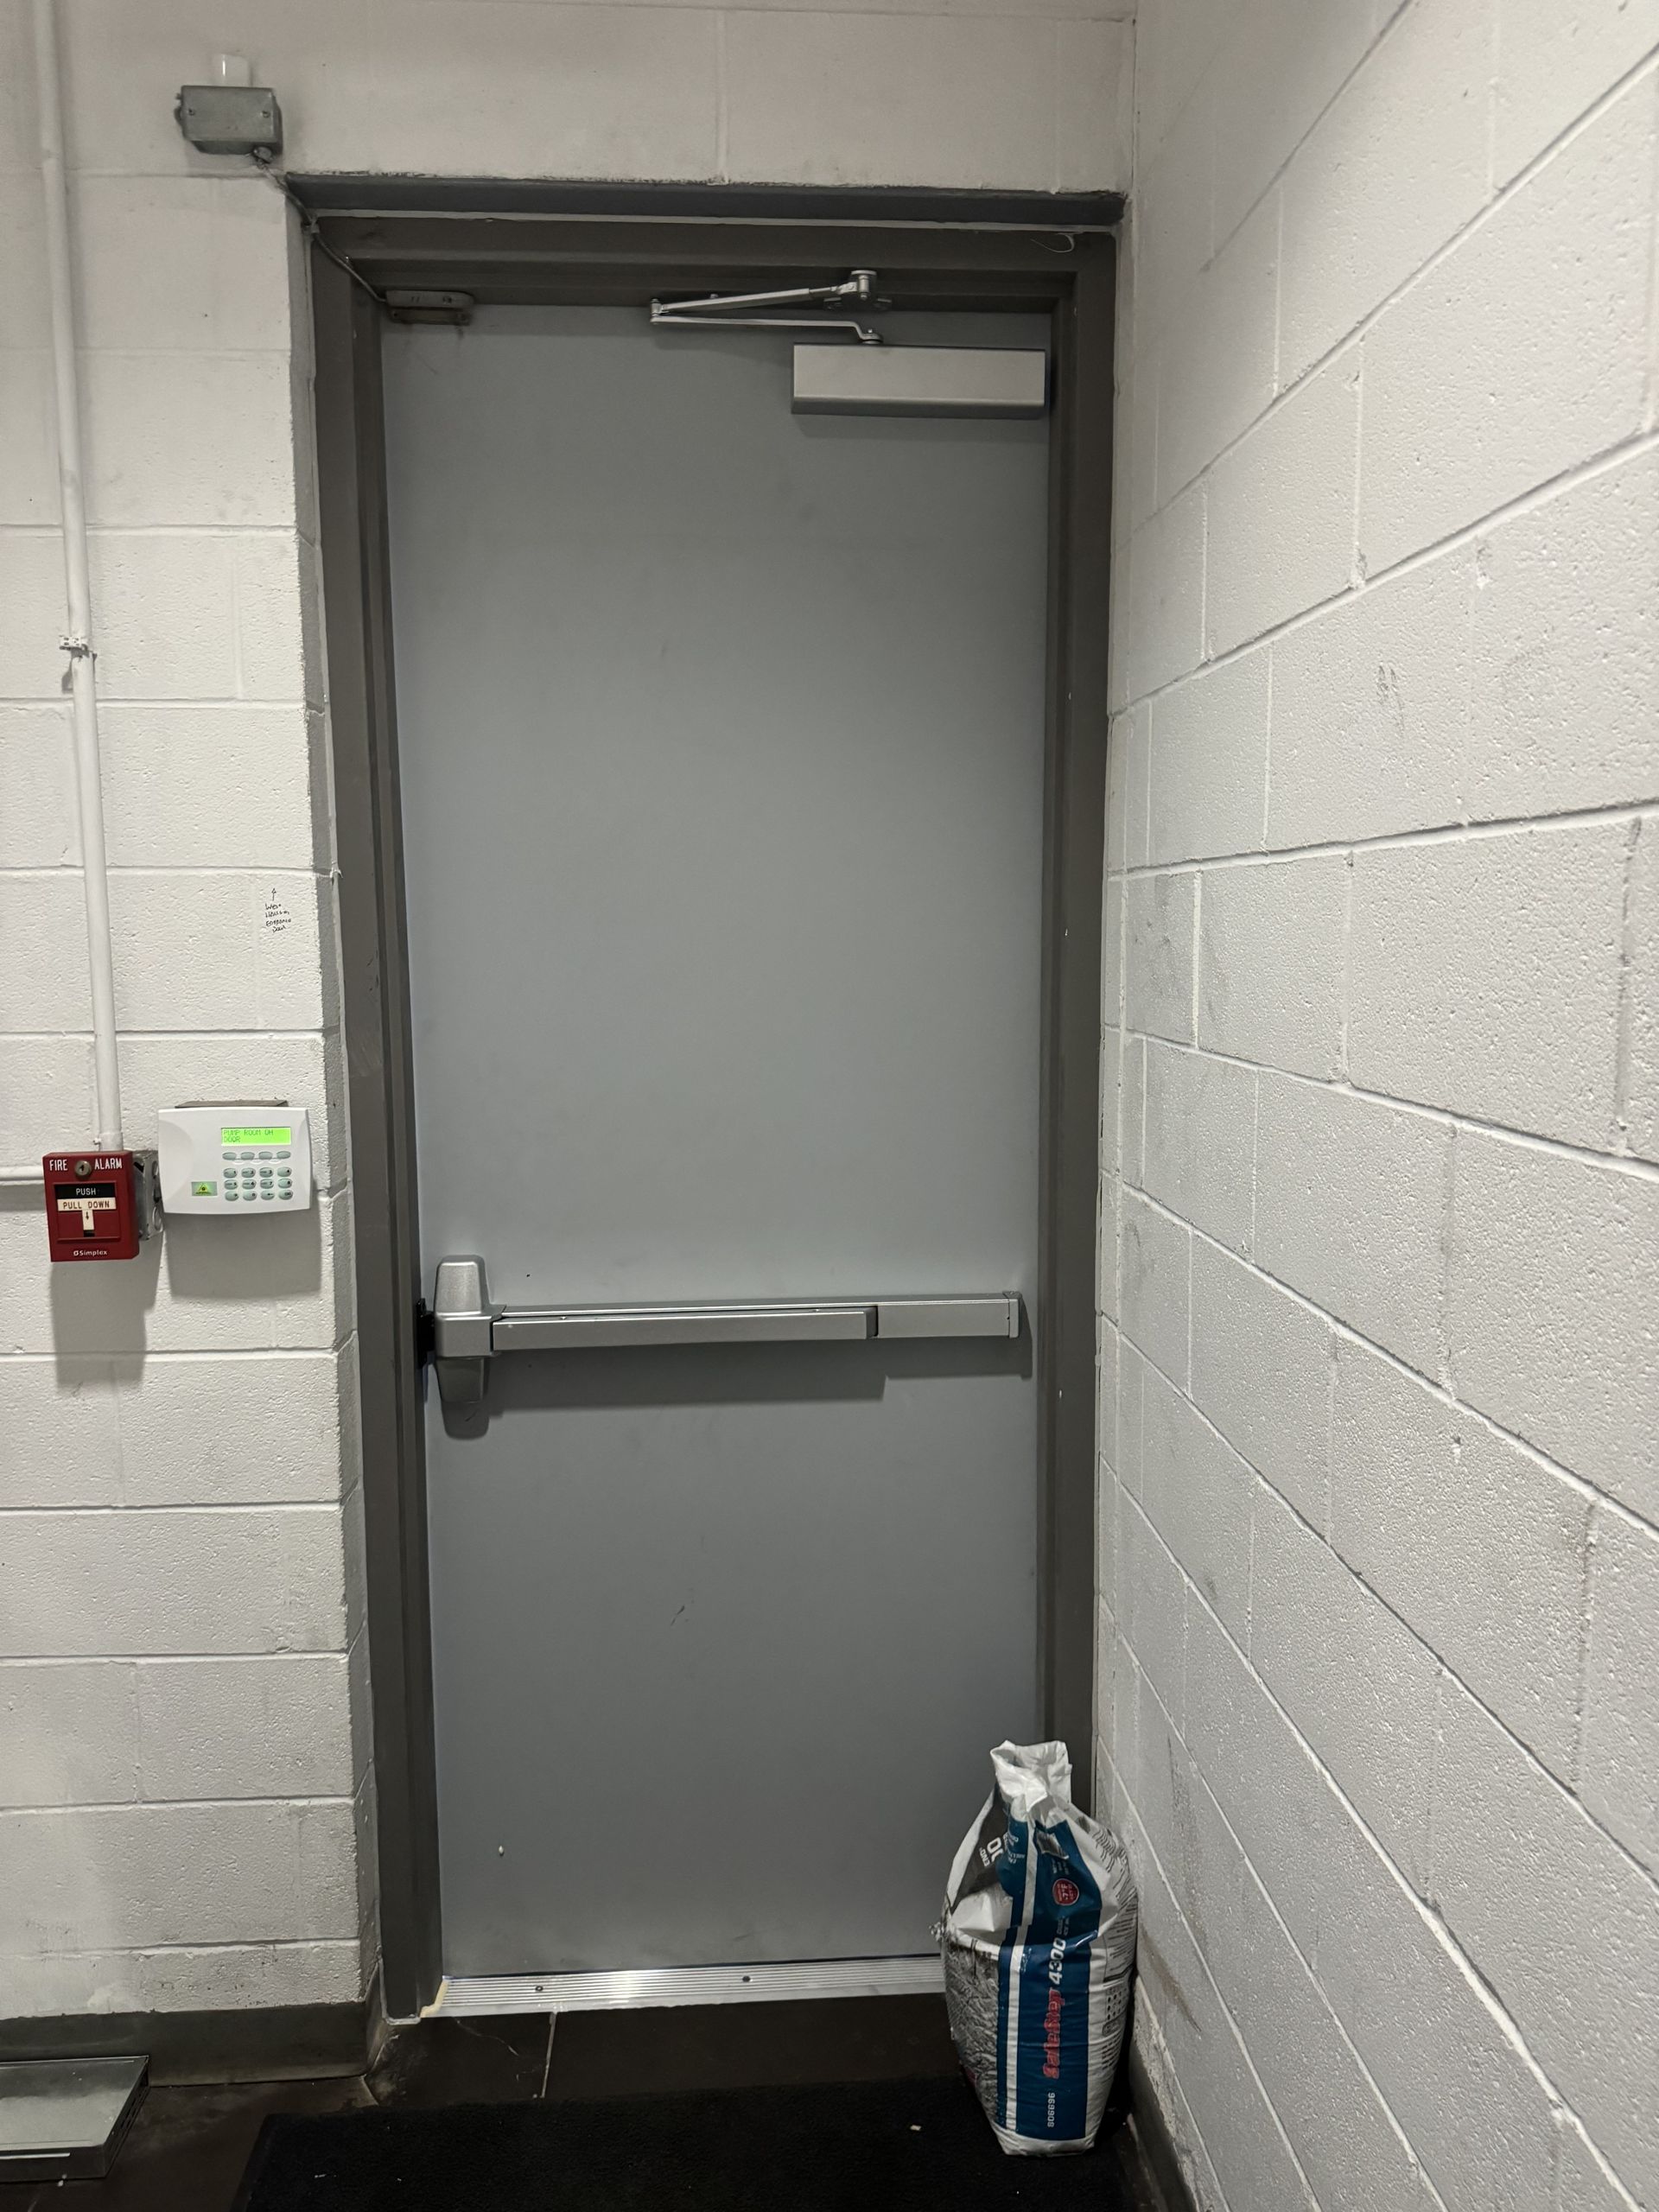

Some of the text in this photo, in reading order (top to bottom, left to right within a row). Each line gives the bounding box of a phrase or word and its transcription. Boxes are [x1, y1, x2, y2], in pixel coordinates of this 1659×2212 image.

[49, 1158, 123, 1171] FIRE ALARM
[75, 1187, 97, 1196] PUSH
[63, 1200, 110, 1210] PULL DOWN
[1042, 1936, 1066, 2080] SafeStep 4300
[1046, 2092, 1057, 2128] 806696
